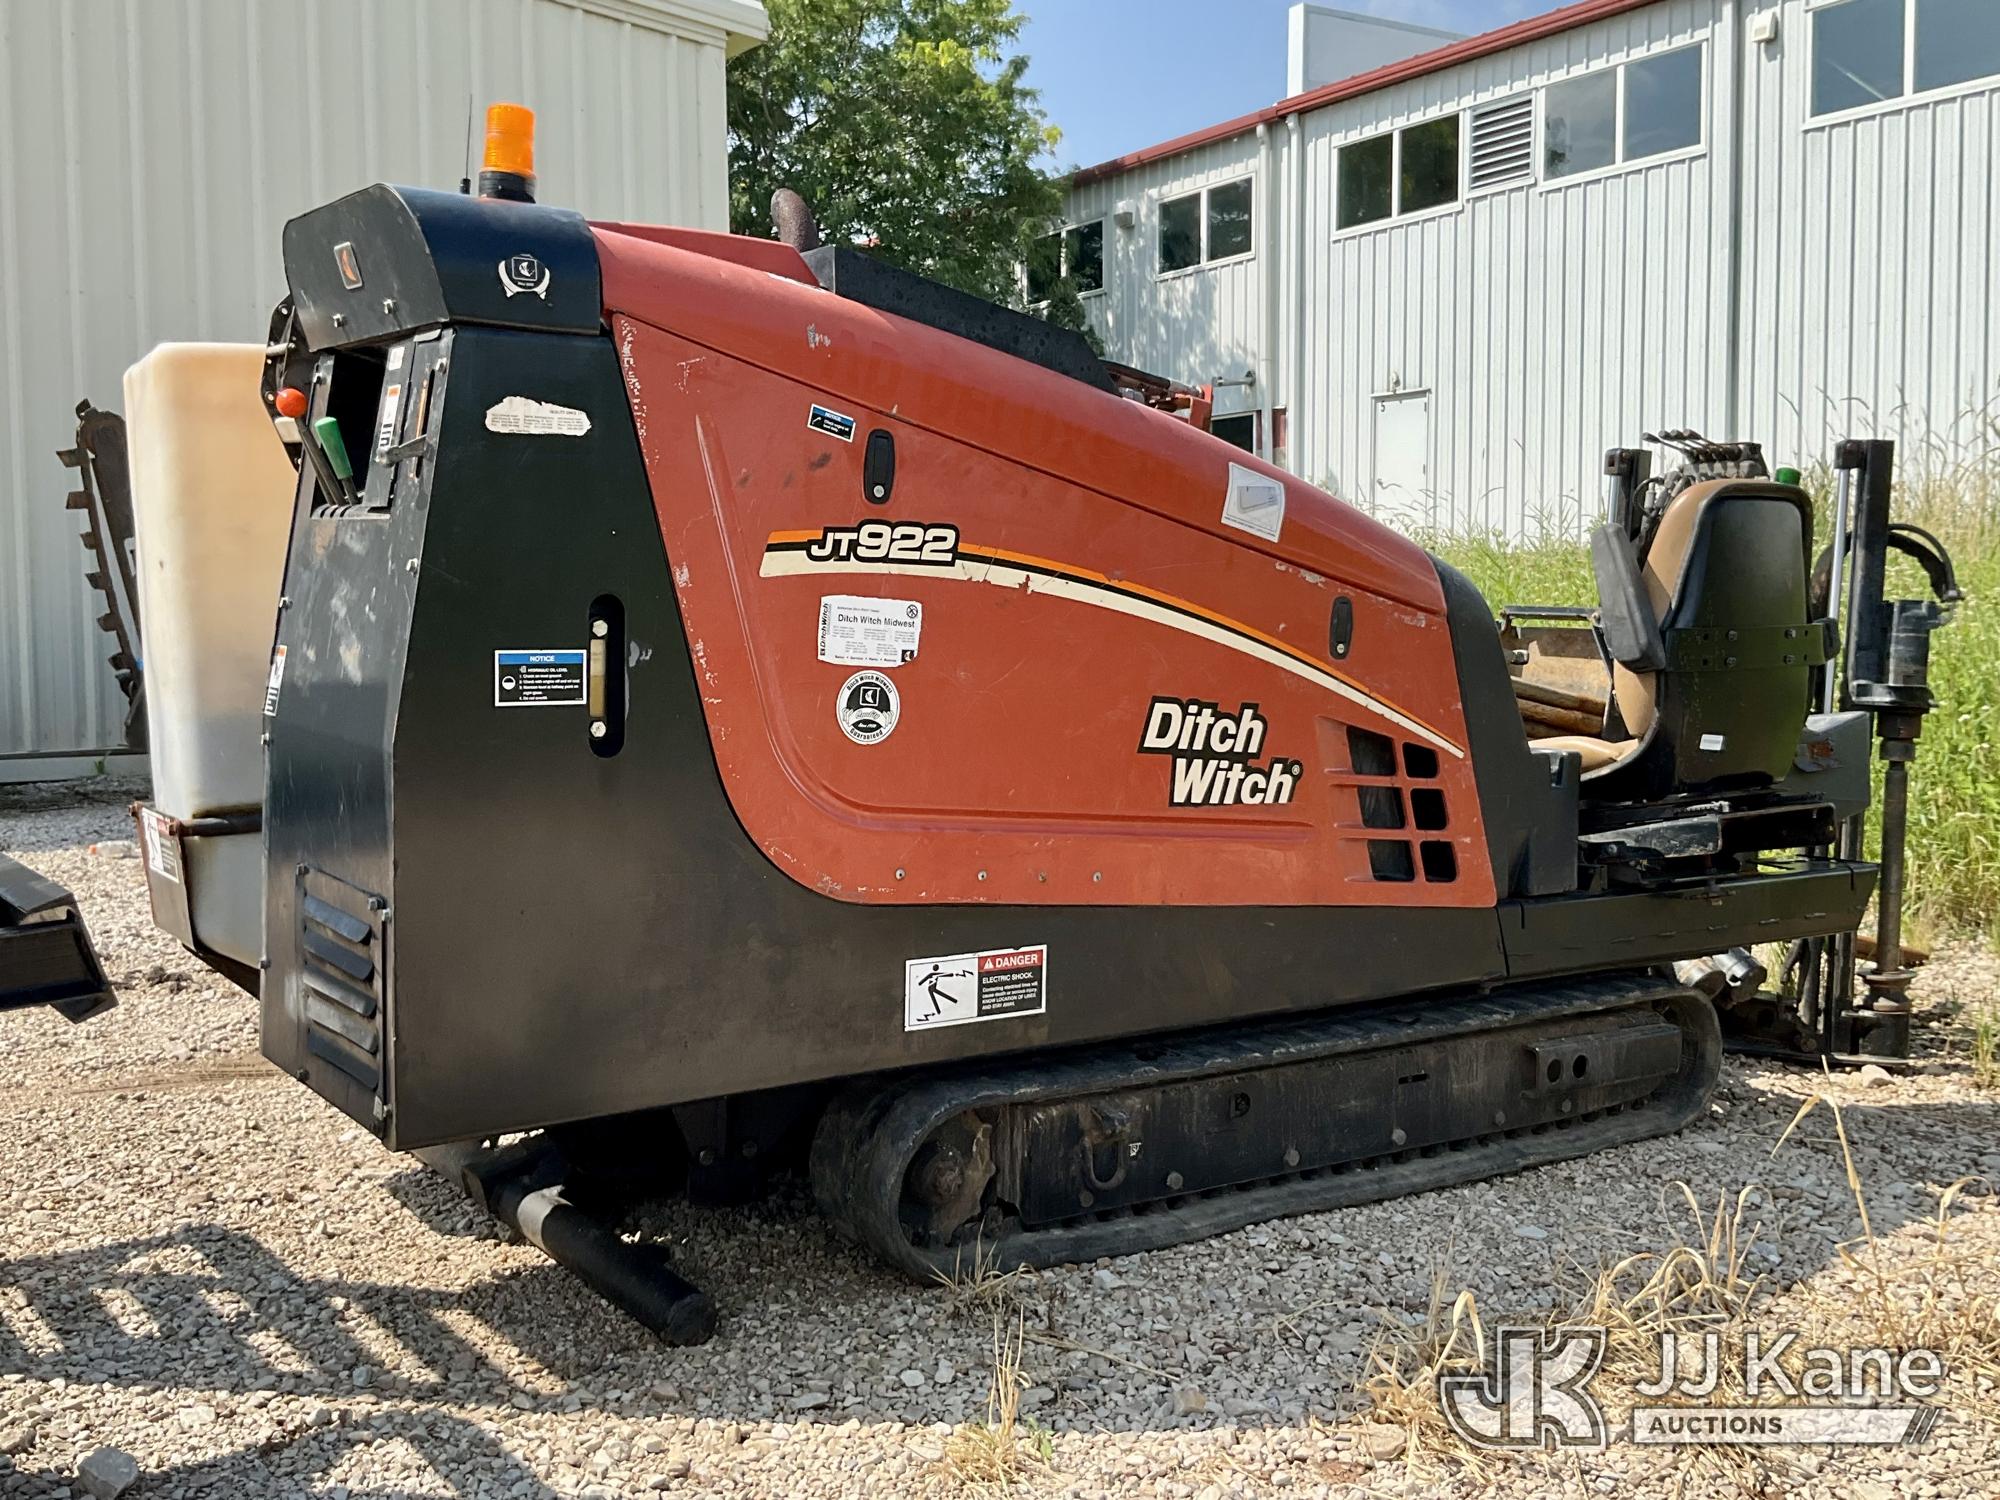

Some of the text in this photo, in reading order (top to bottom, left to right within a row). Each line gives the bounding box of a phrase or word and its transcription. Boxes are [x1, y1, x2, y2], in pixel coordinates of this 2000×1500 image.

[1380, 400, 1386, 413] 5
[809, 522, 957, 563] JT922
[837, 613, 915, 628] Ditch Witch Midwest
[859, 674, 875, 682] Witch
[874, 676, 893, 694] Midwest
[849, 728, 883, 740] Guaranteed
[1142, 702, 1264, 754] Ditch
[995, 953, 1038, 968] DANGER
[982, 974, 1011, 984] ELECTRIC
[995, 995, 1018, 1003] LOCATION
